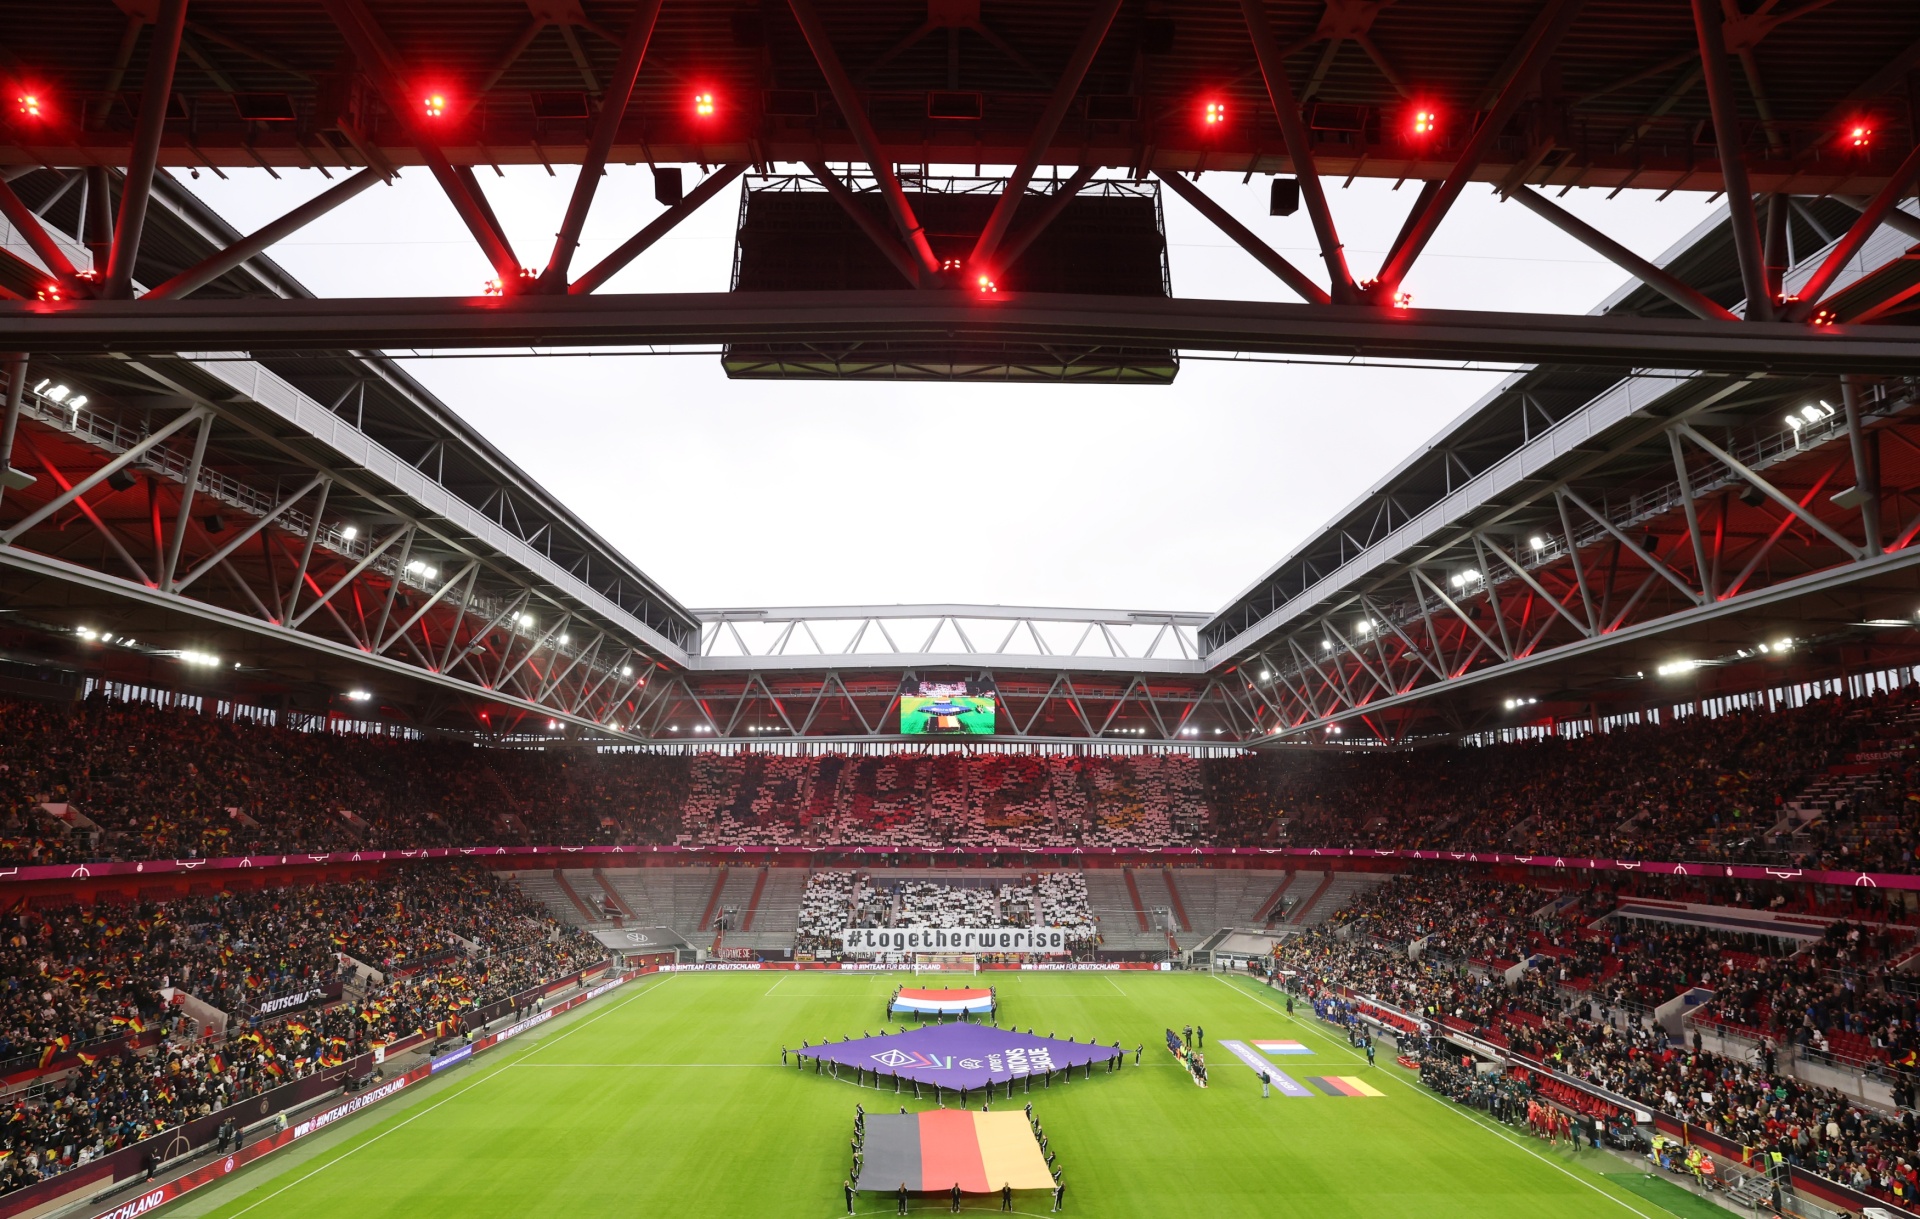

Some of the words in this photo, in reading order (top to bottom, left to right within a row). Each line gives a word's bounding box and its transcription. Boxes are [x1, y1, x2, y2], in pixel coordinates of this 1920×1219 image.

[847, 930, 1061, 951] #togetherwerise
[176, 995, 185, 1004] 26
[1005, 1048, 1031, 1074] NATIONS
[1027, 1047, 1056, 1071] LEAGUE
[294, 1123, 310, 1138] WIR
[316, 1104, 349, 1128] #IMTEAM
[348, 1097, 362, 1112] FÜR
[361, 1078, 405, 1106] DEUTSCHLAND
